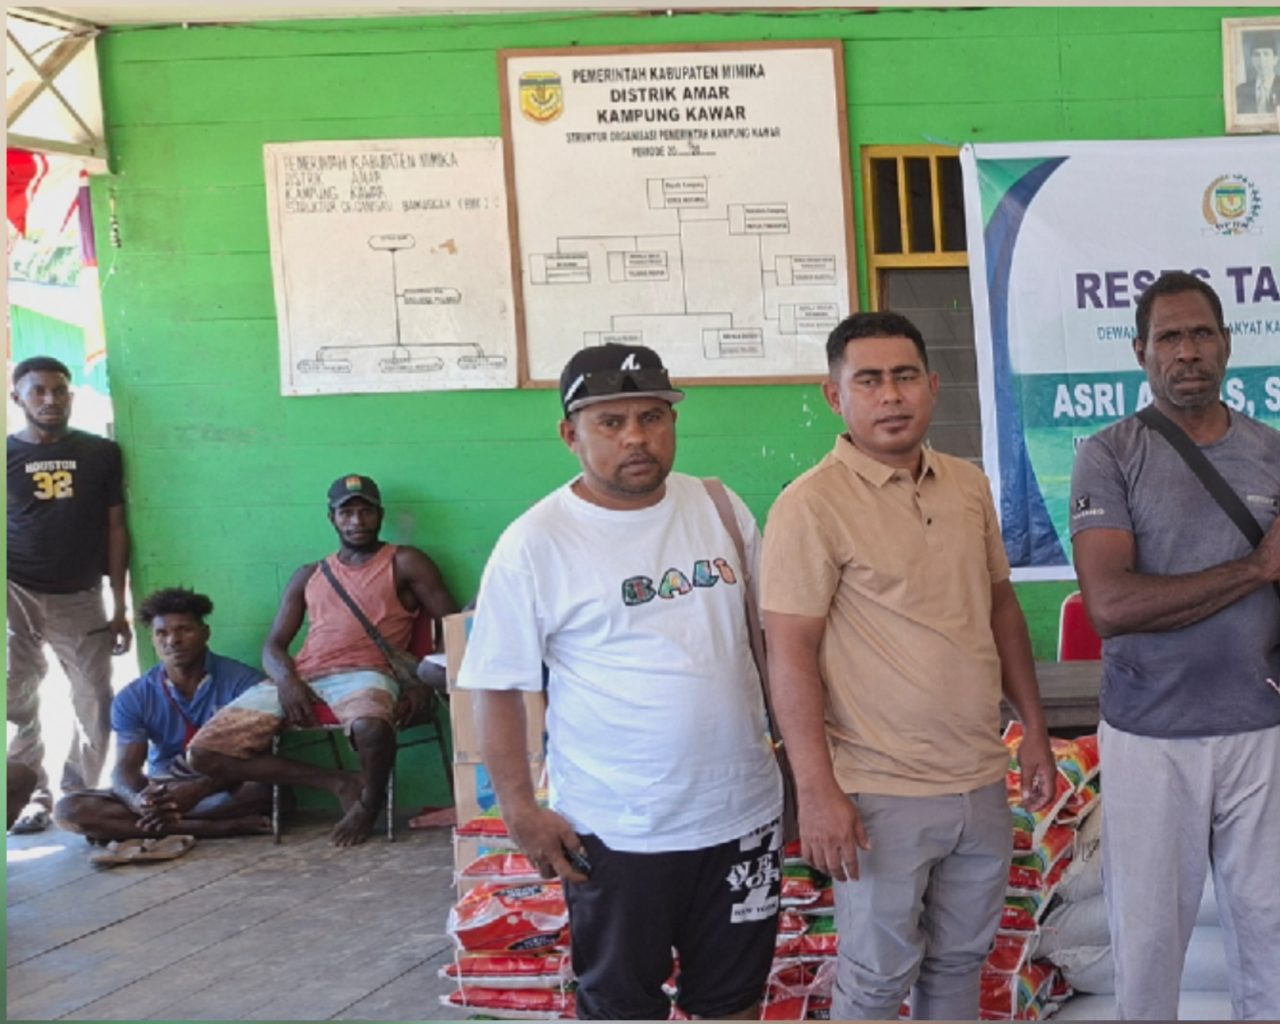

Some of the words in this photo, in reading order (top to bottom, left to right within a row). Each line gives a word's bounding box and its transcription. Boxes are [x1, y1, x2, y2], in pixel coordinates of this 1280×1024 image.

[572, 67, 646, 83] PEMERINTAH
[650, 65, 719, 81] KABUPATEN
[722, 64, 765, 79] MIMIKA
[610, 87, 676, 103] DISTRIK
[683, 86, 730, 100] AMAR
[597, 108, 680, 124] KAMPUNG
[685, 105, 746, 122] KAWAR
[1053, 384, 1125, 418] ASRI
[25, 459, 77, 473] HOUSTON
[32, 469, 74, 501] 32
